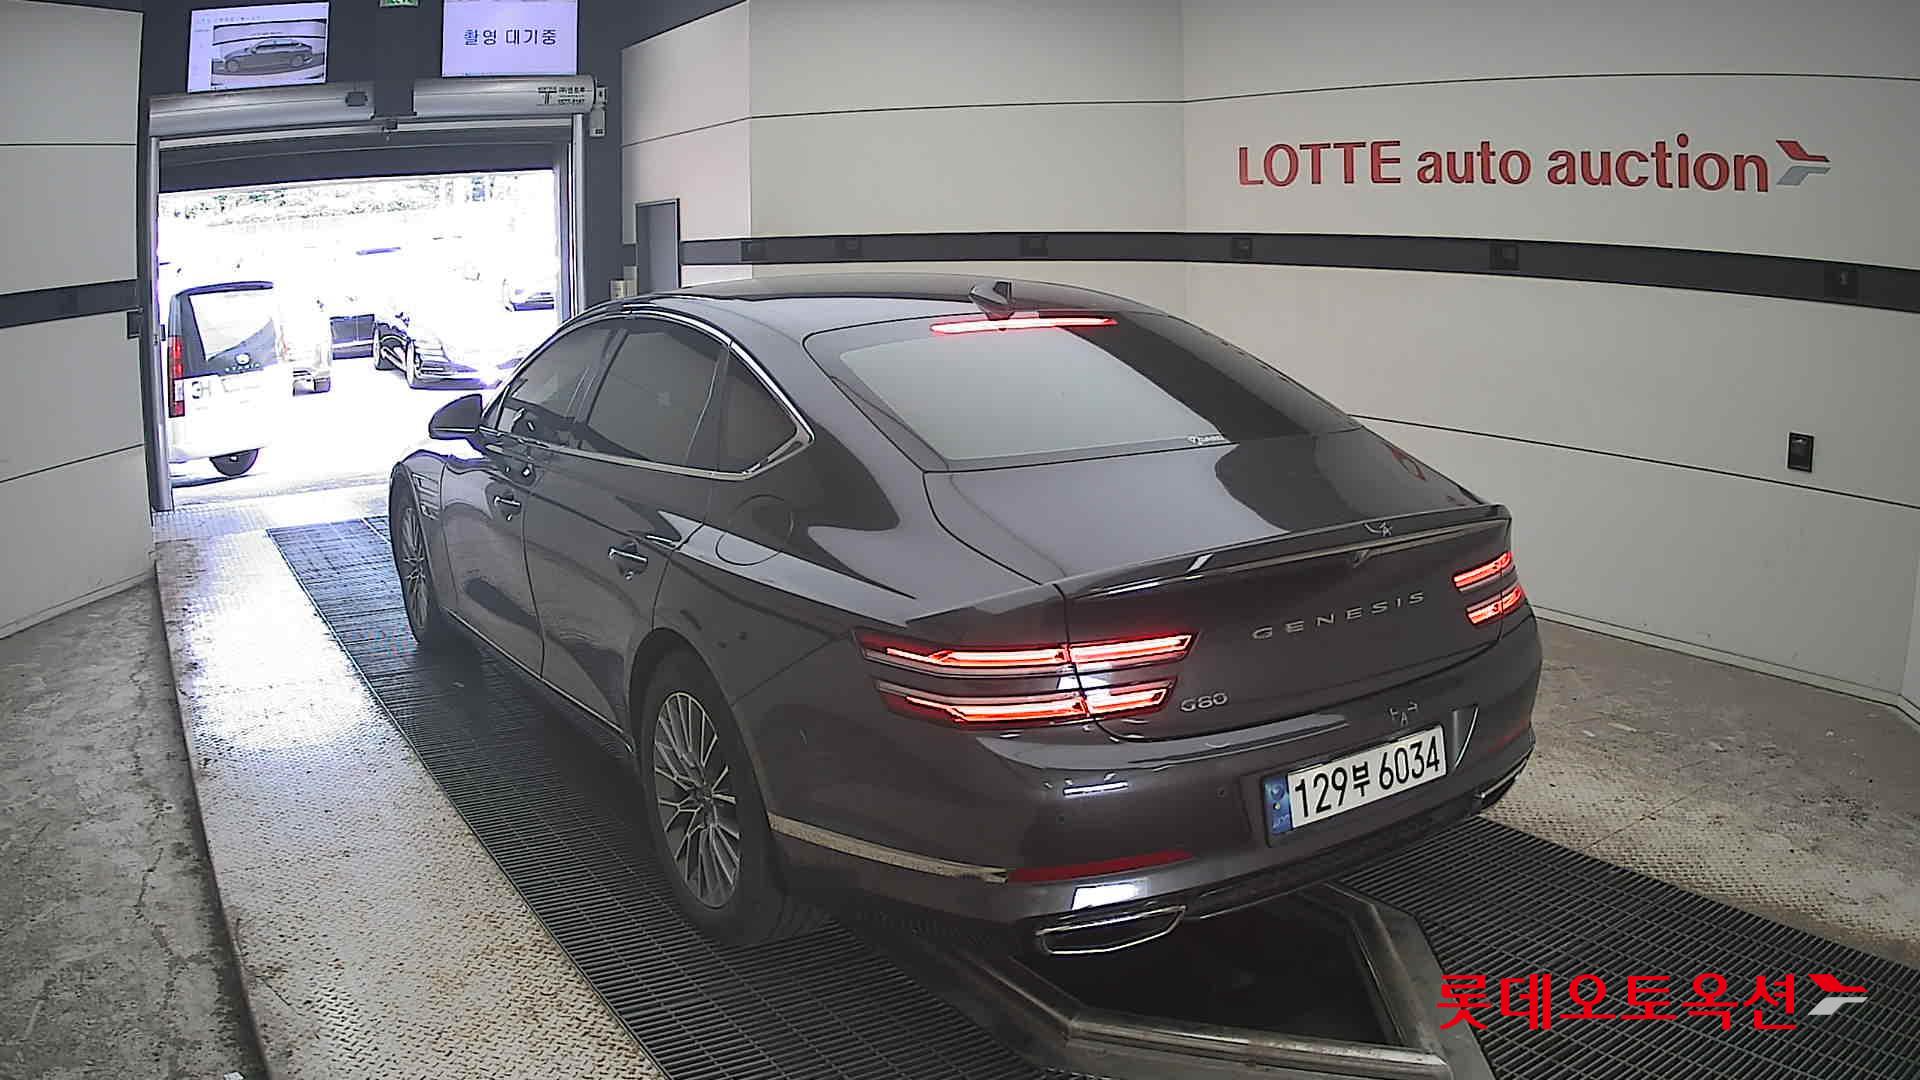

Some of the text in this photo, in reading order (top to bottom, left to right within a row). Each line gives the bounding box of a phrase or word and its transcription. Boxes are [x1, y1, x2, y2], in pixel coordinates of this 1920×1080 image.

[463, 29, 557, 46] 촬영 대기중
[1238, 133, 1769, 193] LOTTE auto auction
[1251, 591, 1425, 641] GENESIS
[1294, 735, 1441, 818] 129부 6034
